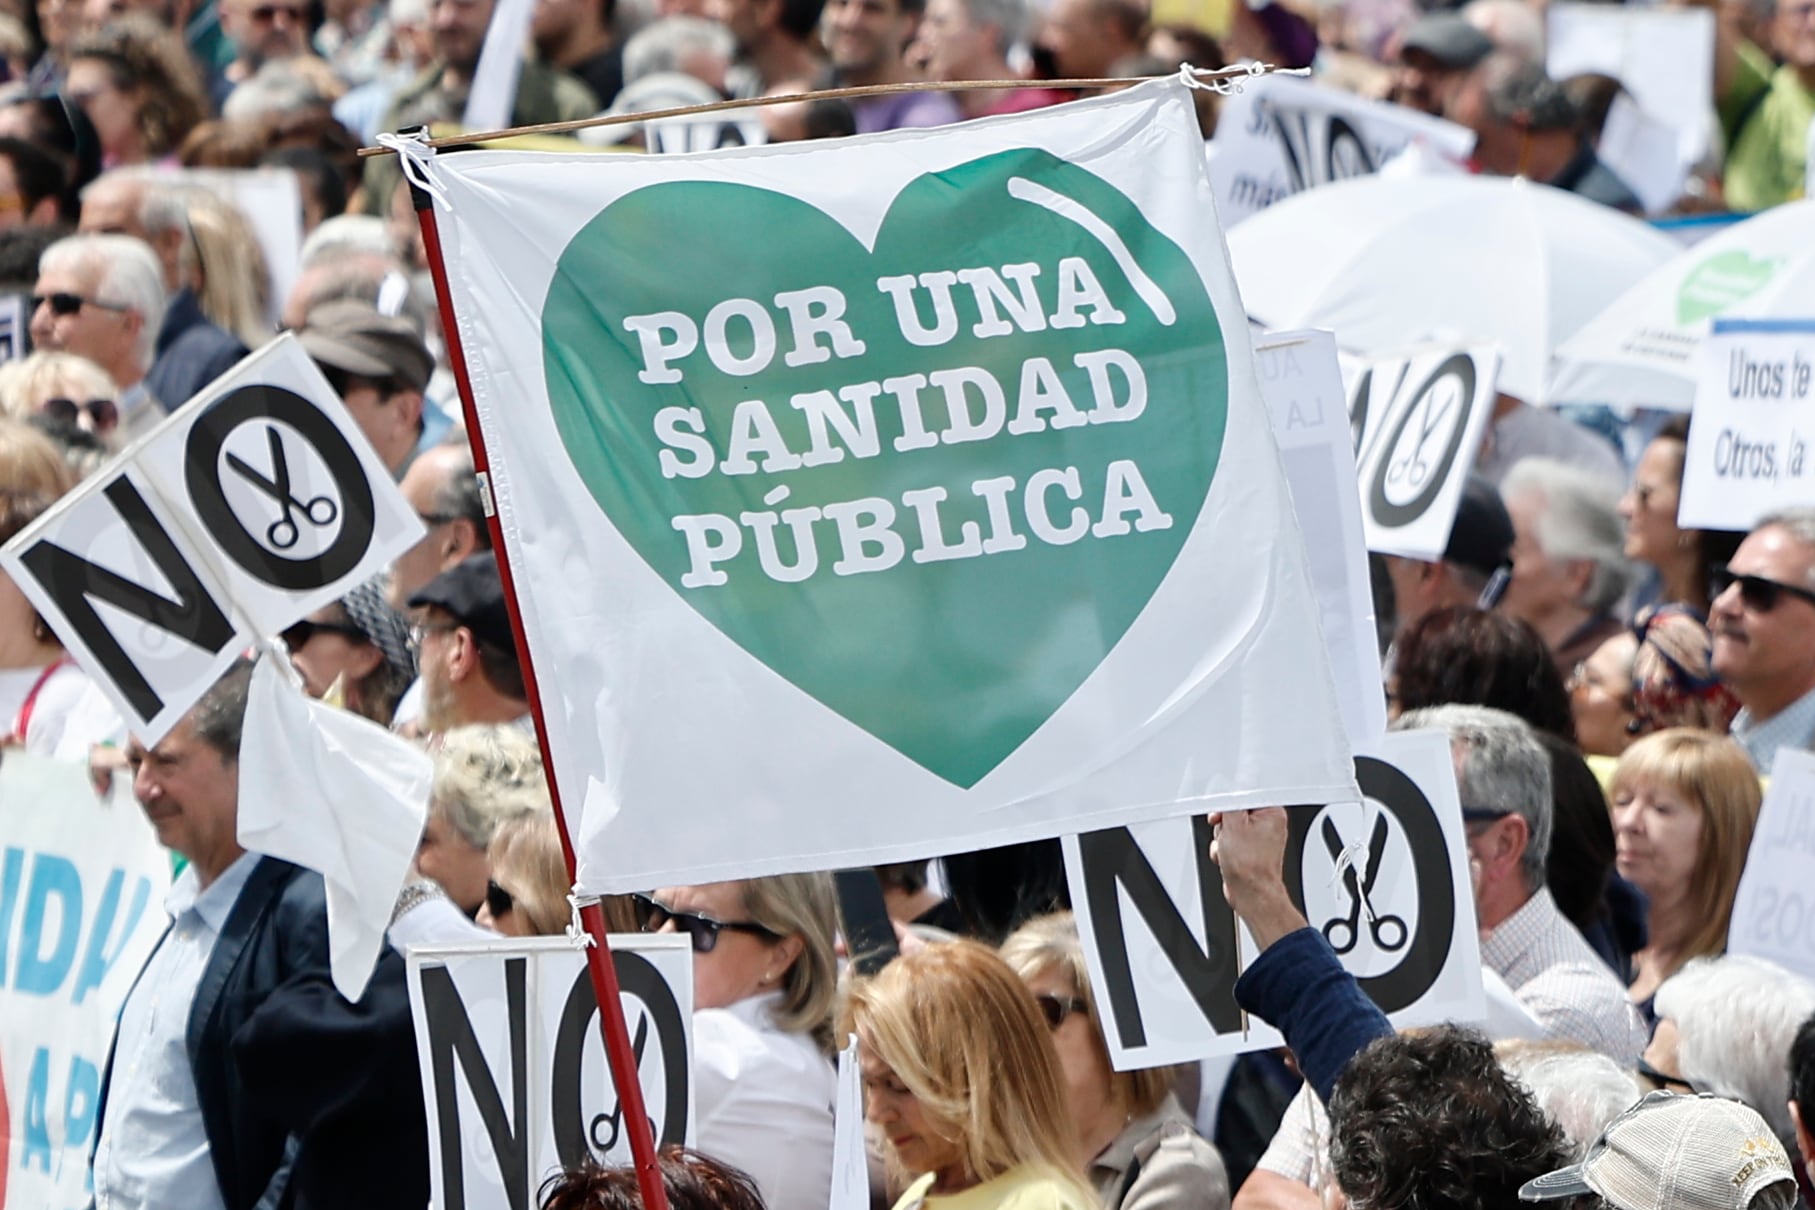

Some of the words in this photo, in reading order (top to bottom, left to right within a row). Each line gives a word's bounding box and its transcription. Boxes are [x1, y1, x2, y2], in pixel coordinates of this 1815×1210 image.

[624, 285, 866, 384] POR
[877, 256, 1125, 346] UNA
[1729, 348, 1784, 400] Unos
[1791, 350, 1810, 399] te
[653, 348, 1148, 479] SANIDAD
[1787, 428, 1804, 477] la
[20, 384, 375, 724] NO
[671, 460, 1172, 588] PÚBLICA
[1078, 755, 1456, 1050] NO
